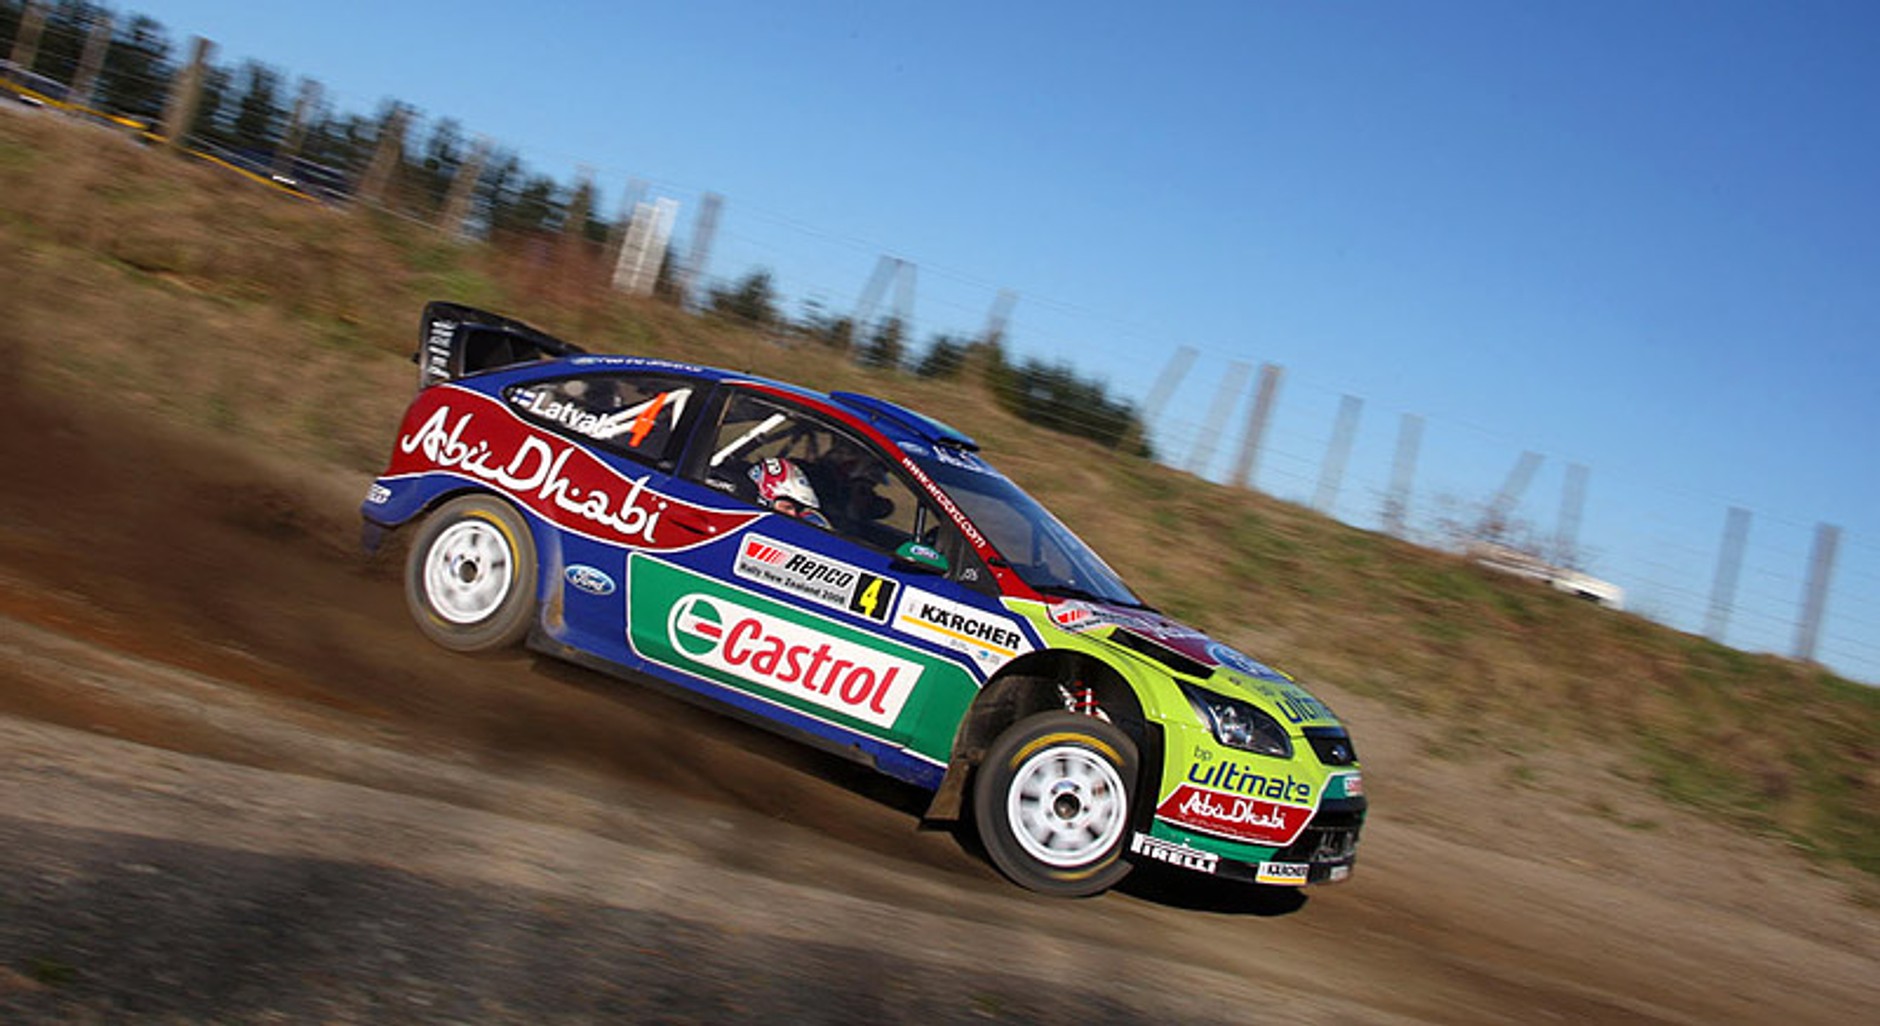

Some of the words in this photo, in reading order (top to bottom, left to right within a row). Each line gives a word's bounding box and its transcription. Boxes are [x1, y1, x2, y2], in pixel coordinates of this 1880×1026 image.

[498, 434, 668, 543] Dhabi
[740, 562, 762, 576] Rally
[764, 570, 782, 582] New
[784, 577, 821, 595] Zealand
[822, 589, 845, 604] 2008
[785, 554, 853, 588] Repco
[860, 578, 883, 617] 4
[920, 603, 1021, 650] KÄRCHER
[723, 618, 899, 715] Castrol
[1194, 746, 1213, 761] bp
[1188, 761, 1310, 804] ultimate
[1231, 799, 1286, 830] Dhabi
[1130, 832, 1219, 874] PIRELLI
